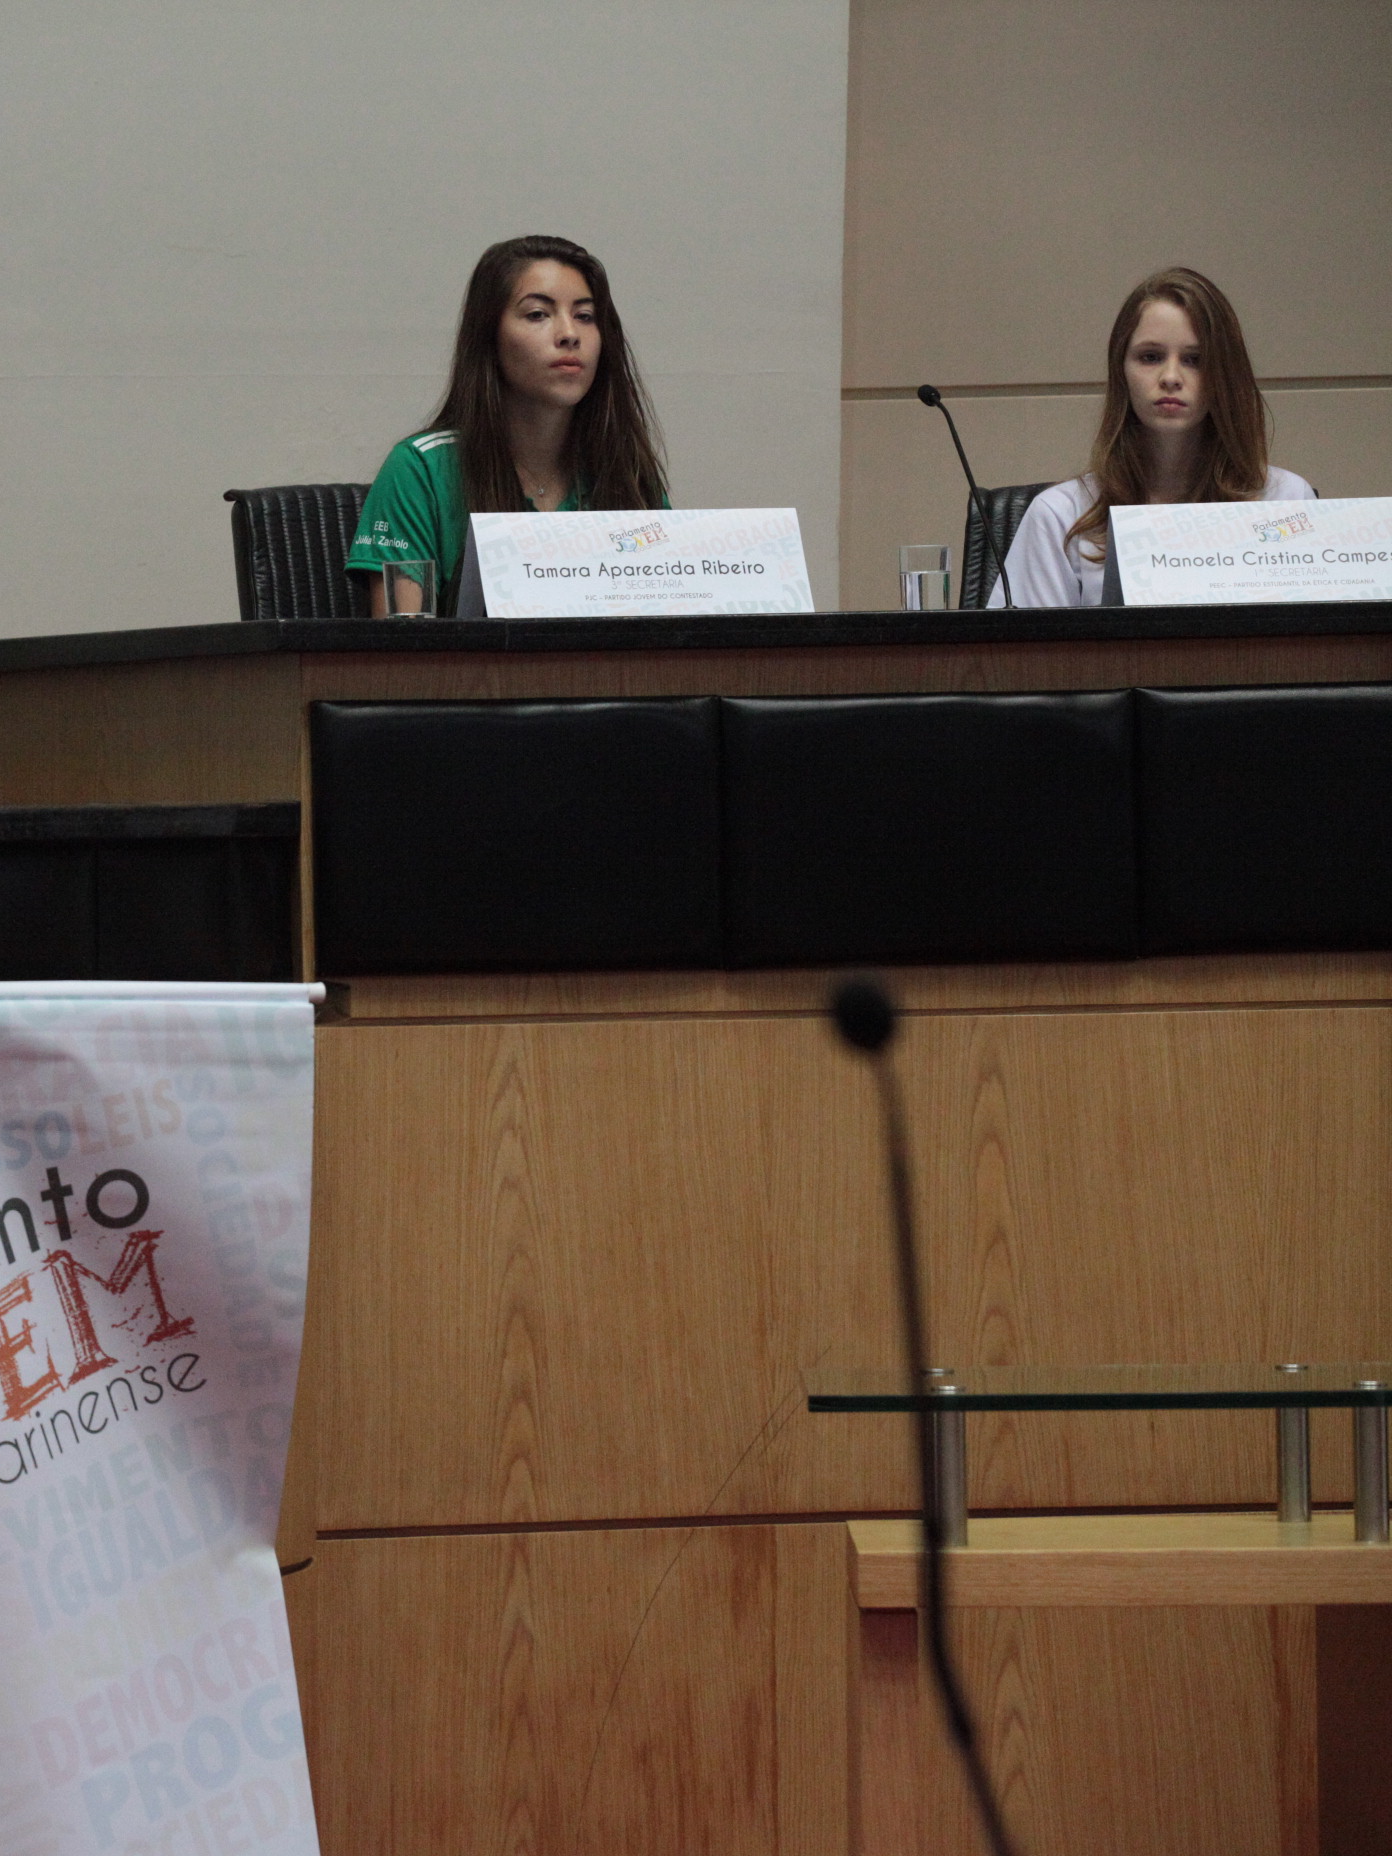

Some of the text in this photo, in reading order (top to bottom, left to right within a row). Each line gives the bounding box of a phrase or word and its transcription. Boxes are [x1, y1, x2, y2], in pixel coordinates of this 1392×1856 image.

[374, 521, 389, 532] EEB
[608, 521, 661, 543] Parlamento
[1252, 512, 1307, 534] Parlamento
[522, 562, 591, 579] Tamara
[598, 560, 695, 580] Aparecida
[701, 559, 765, 575] Ribeiro
[1151, 552, 1234, 569] Manoela
[1242, 549, 1314, 566] Cristina
[70, 1077, 182, 1156] LEIS
